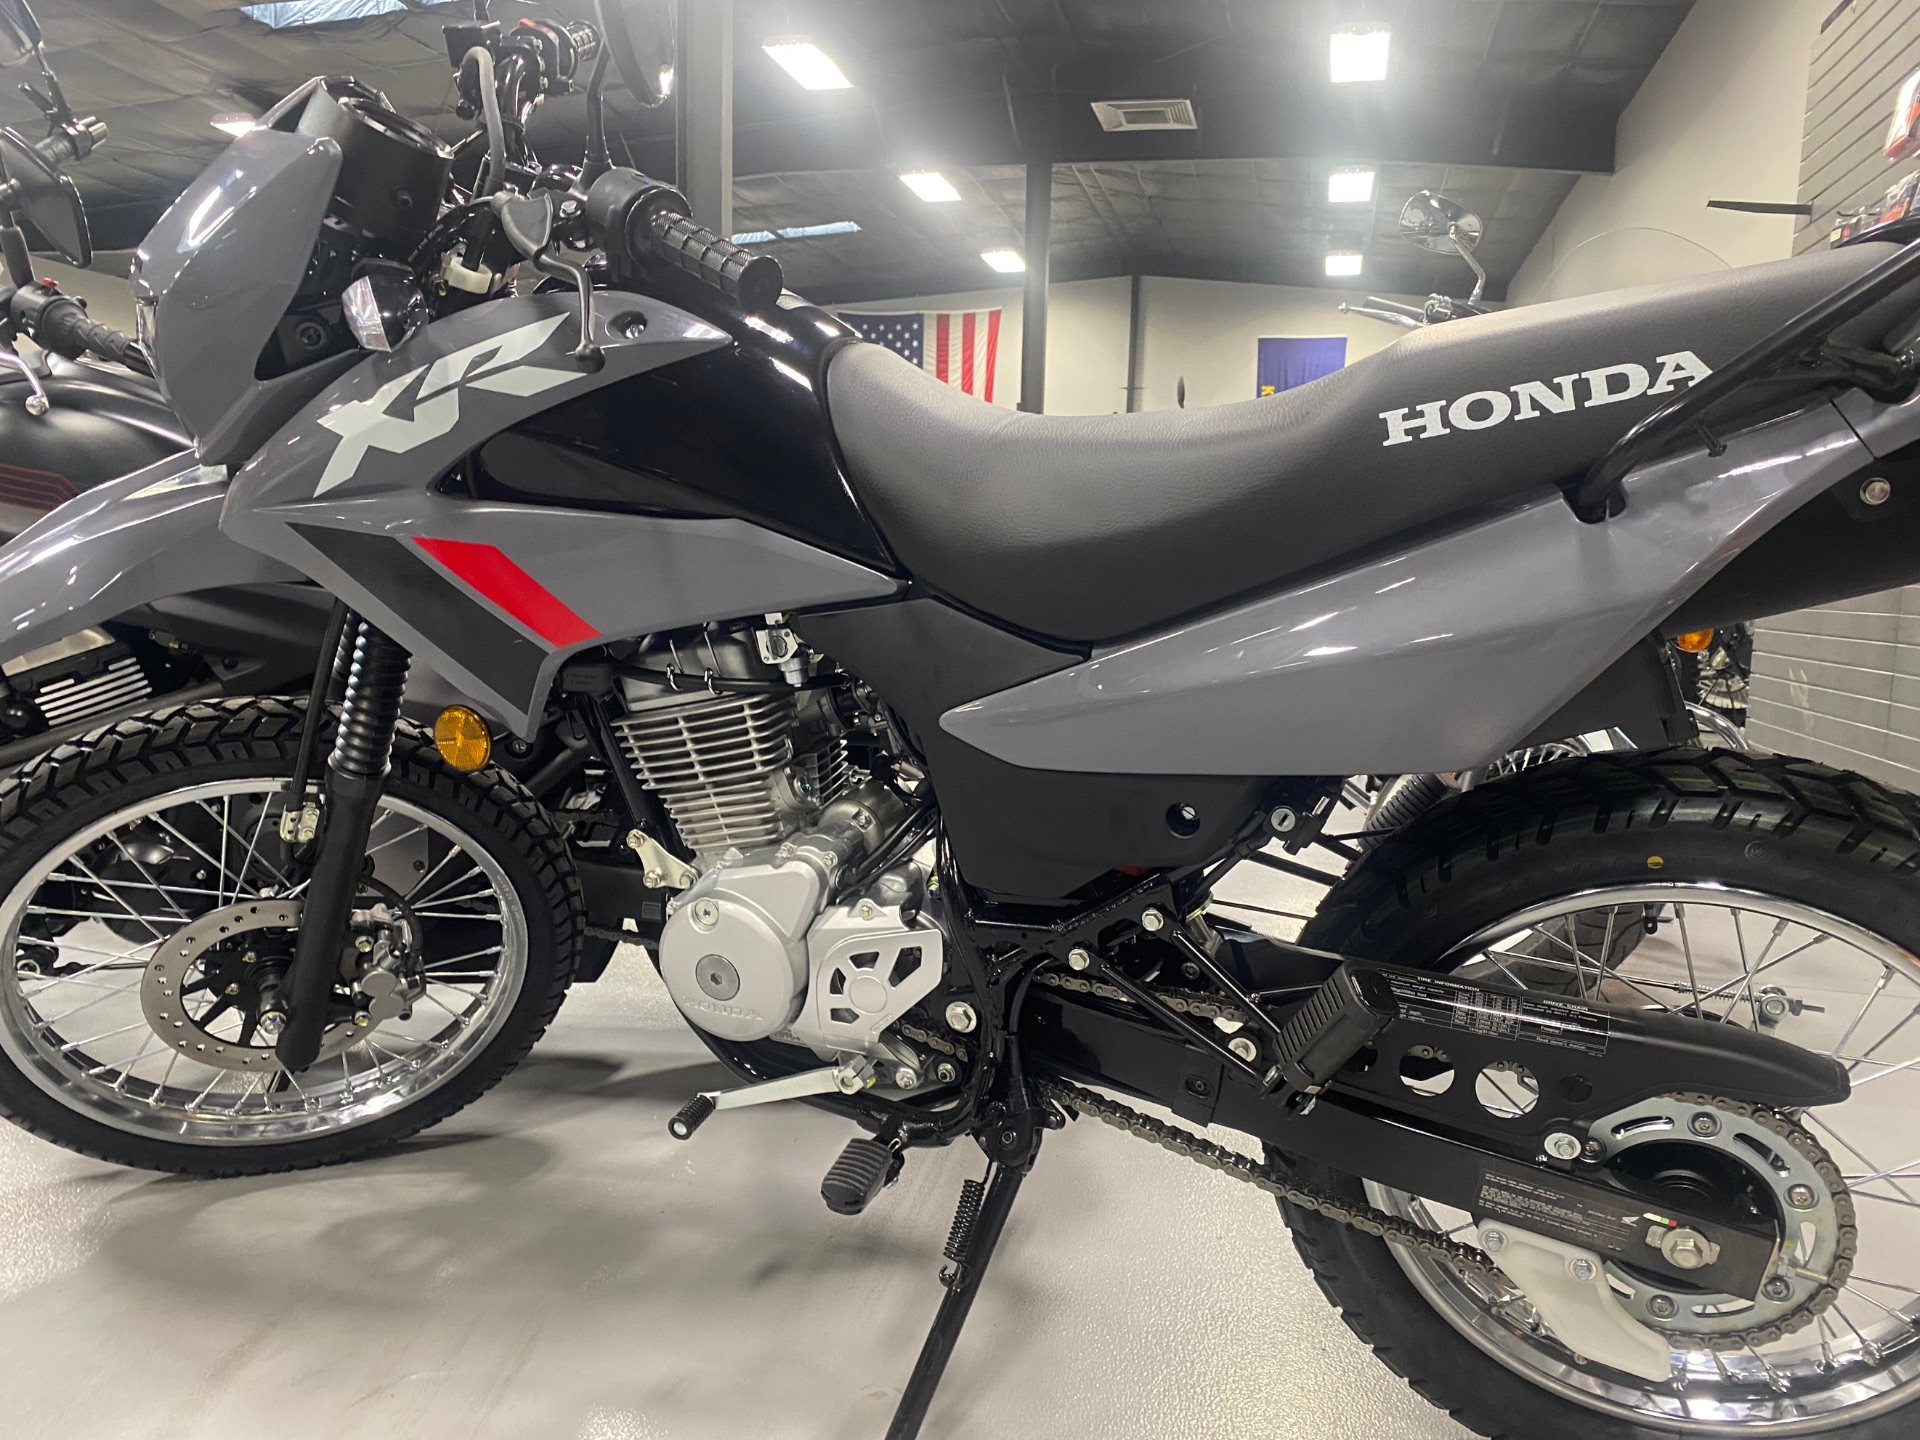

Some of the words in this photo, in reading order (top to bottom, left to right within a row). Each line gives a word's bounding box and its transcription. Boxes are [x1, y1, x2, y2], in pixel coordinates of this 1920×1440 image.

[314, 311, 588, 497] XR
[1378, 350, 1714, 446] HONDA
[682, 995, 765, 1021] HONDA
[1417, 976, 1431, 984] TIRE
[1434, 980, 1480, 992] INFORMATION
